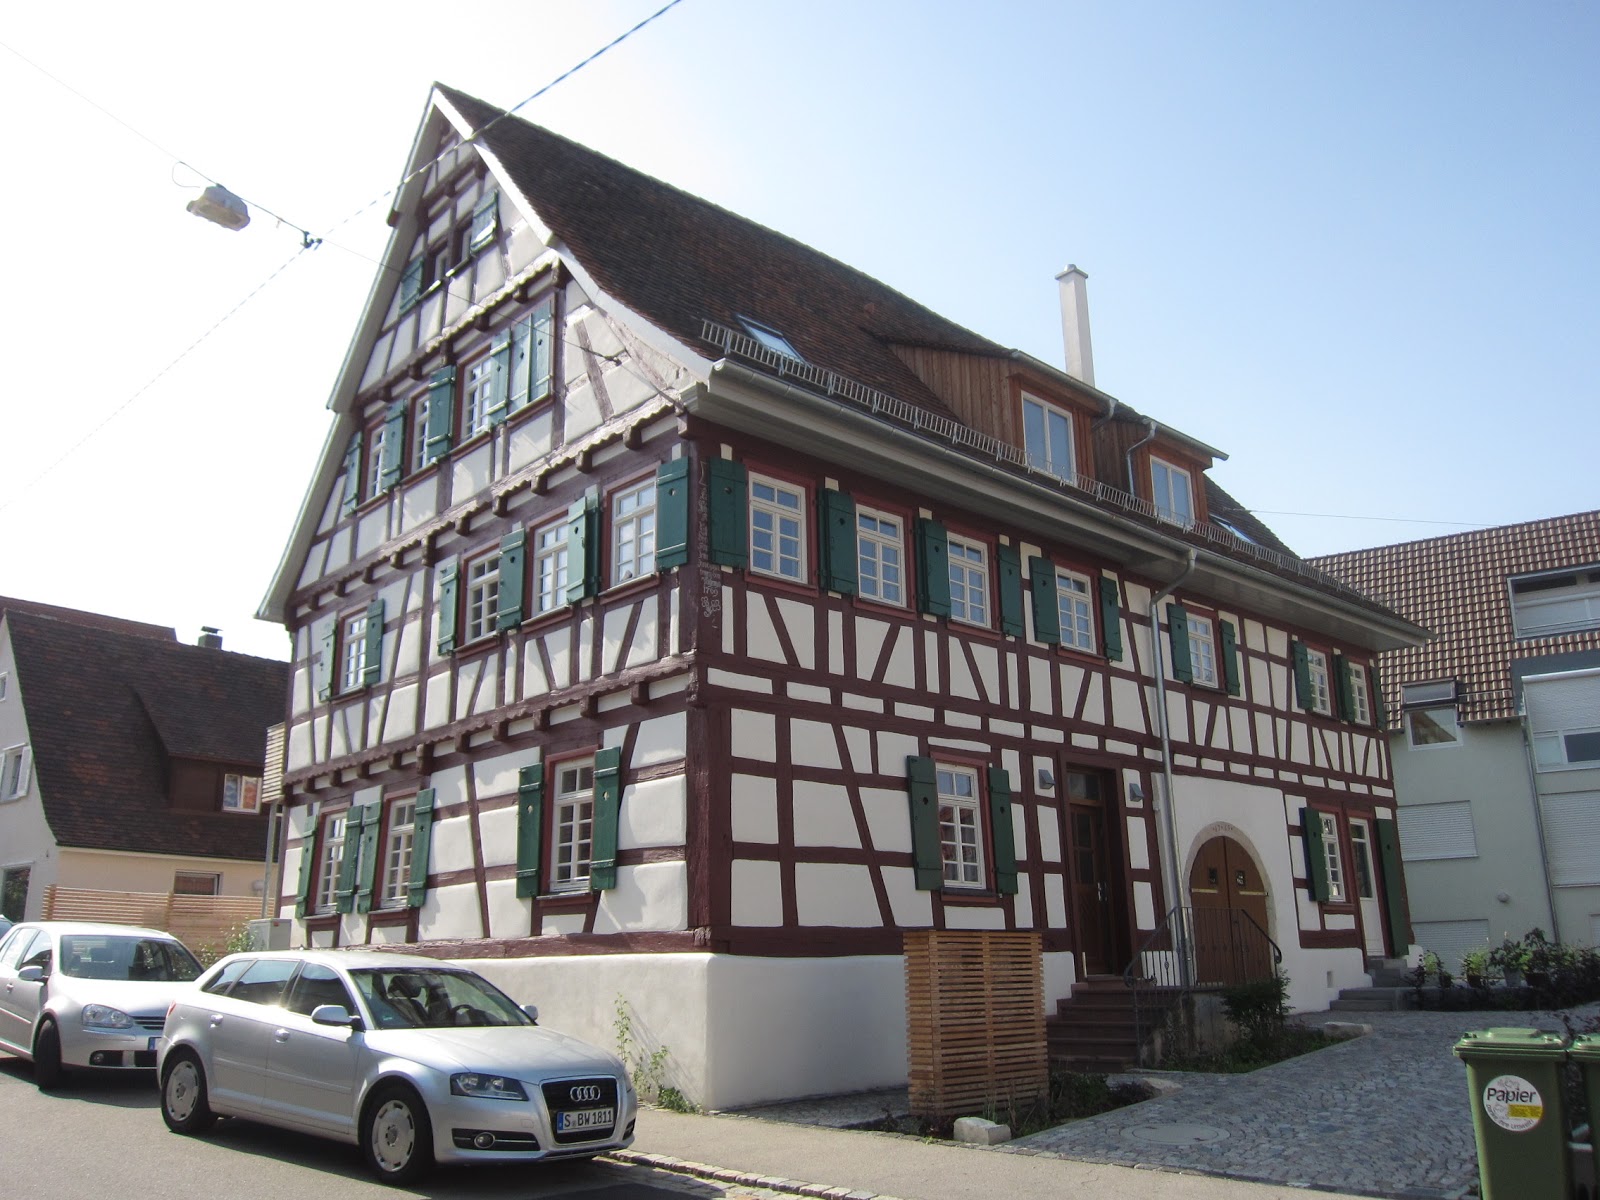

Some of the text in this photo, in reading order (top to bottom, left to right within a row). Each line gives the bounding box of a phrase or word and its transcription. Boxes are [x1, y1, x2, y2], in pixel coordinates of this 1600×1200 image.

[1487, 1087, 1536, 1103] Papier
[564, 1110, 612, 1127] S BW 1811
